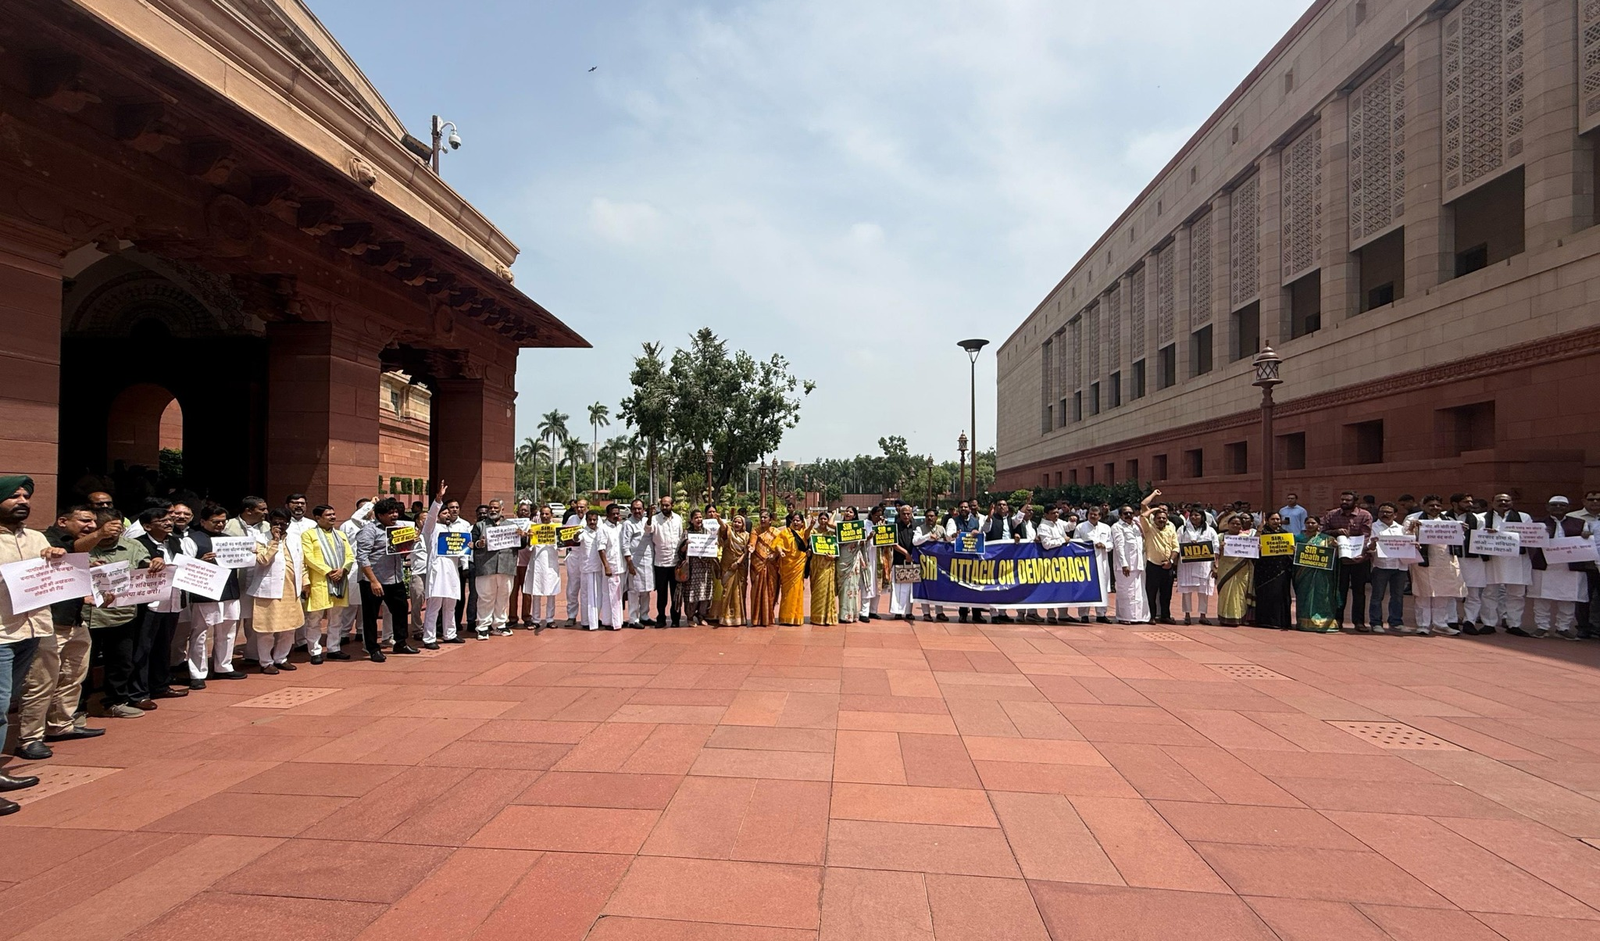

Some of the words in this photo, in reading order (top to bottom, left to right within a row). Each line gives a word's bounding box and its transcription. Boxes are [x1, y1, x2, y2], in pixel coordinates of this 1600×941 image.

[1184, 544, 1210, 556] NDA
[1305, 546, 1318, 554] SIR
[1300, 552, 1319, 561] Death
[1300, 559, 1327, 568] Democracy
[108, 568, 122, 577] आयोग
[920, 555, 938, 581] SIR
[950, 558, 995, 585] ATTACK
[999, 560, 1015, 585] ON
[1018, 556, 1091, 585] DEMOCRACY
